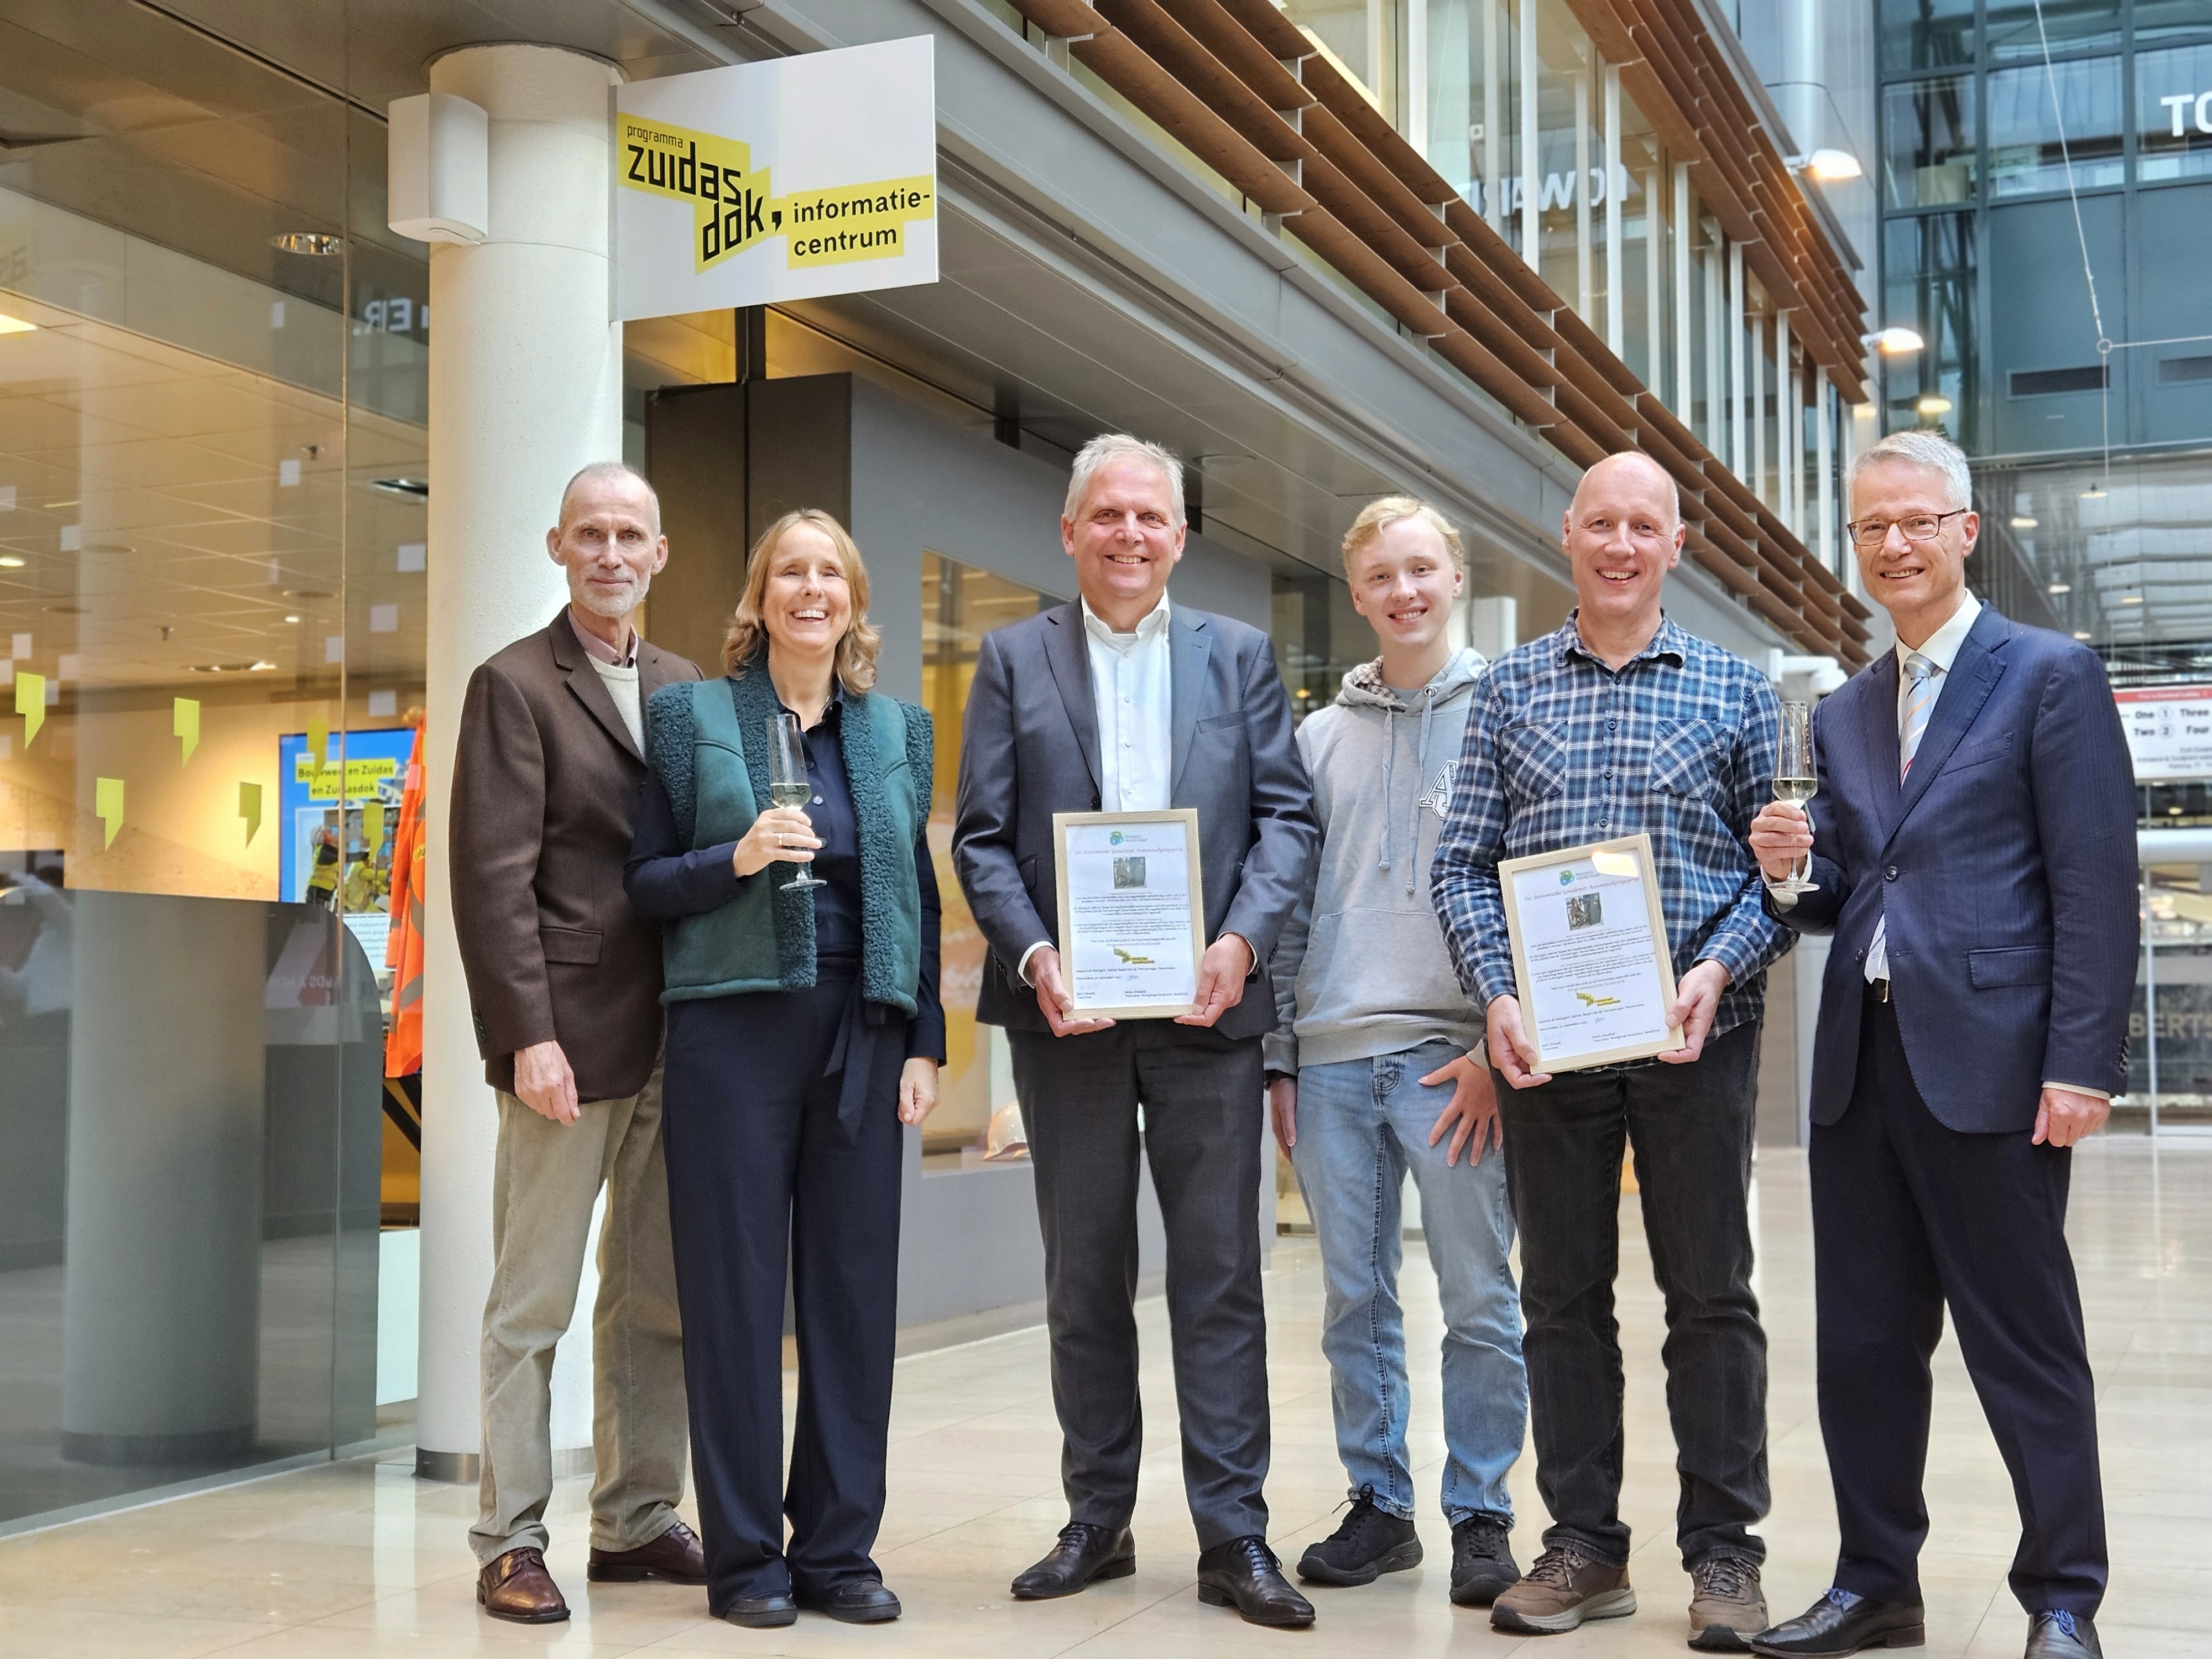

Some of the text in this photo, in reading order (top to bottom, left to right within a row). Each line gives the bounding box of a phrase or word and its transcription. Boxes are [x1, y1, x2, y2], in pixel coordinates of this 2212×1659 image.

[627, 125, 684, 148] programma
[628, 142, 742, 207] zuidas
[794, 187, 931, 223] informatie-
[794, 228, 897, 257] centrum
[2135, 711, 2154, 719] One
[2180, 708, 2209, 717] Three
[2134, 728, 2155, 736] Two
[2186, 726, 2209, 734] Four
[361, 765, 394, 775] Zuidas
[325, 783, 375, 795] Zuasdok
